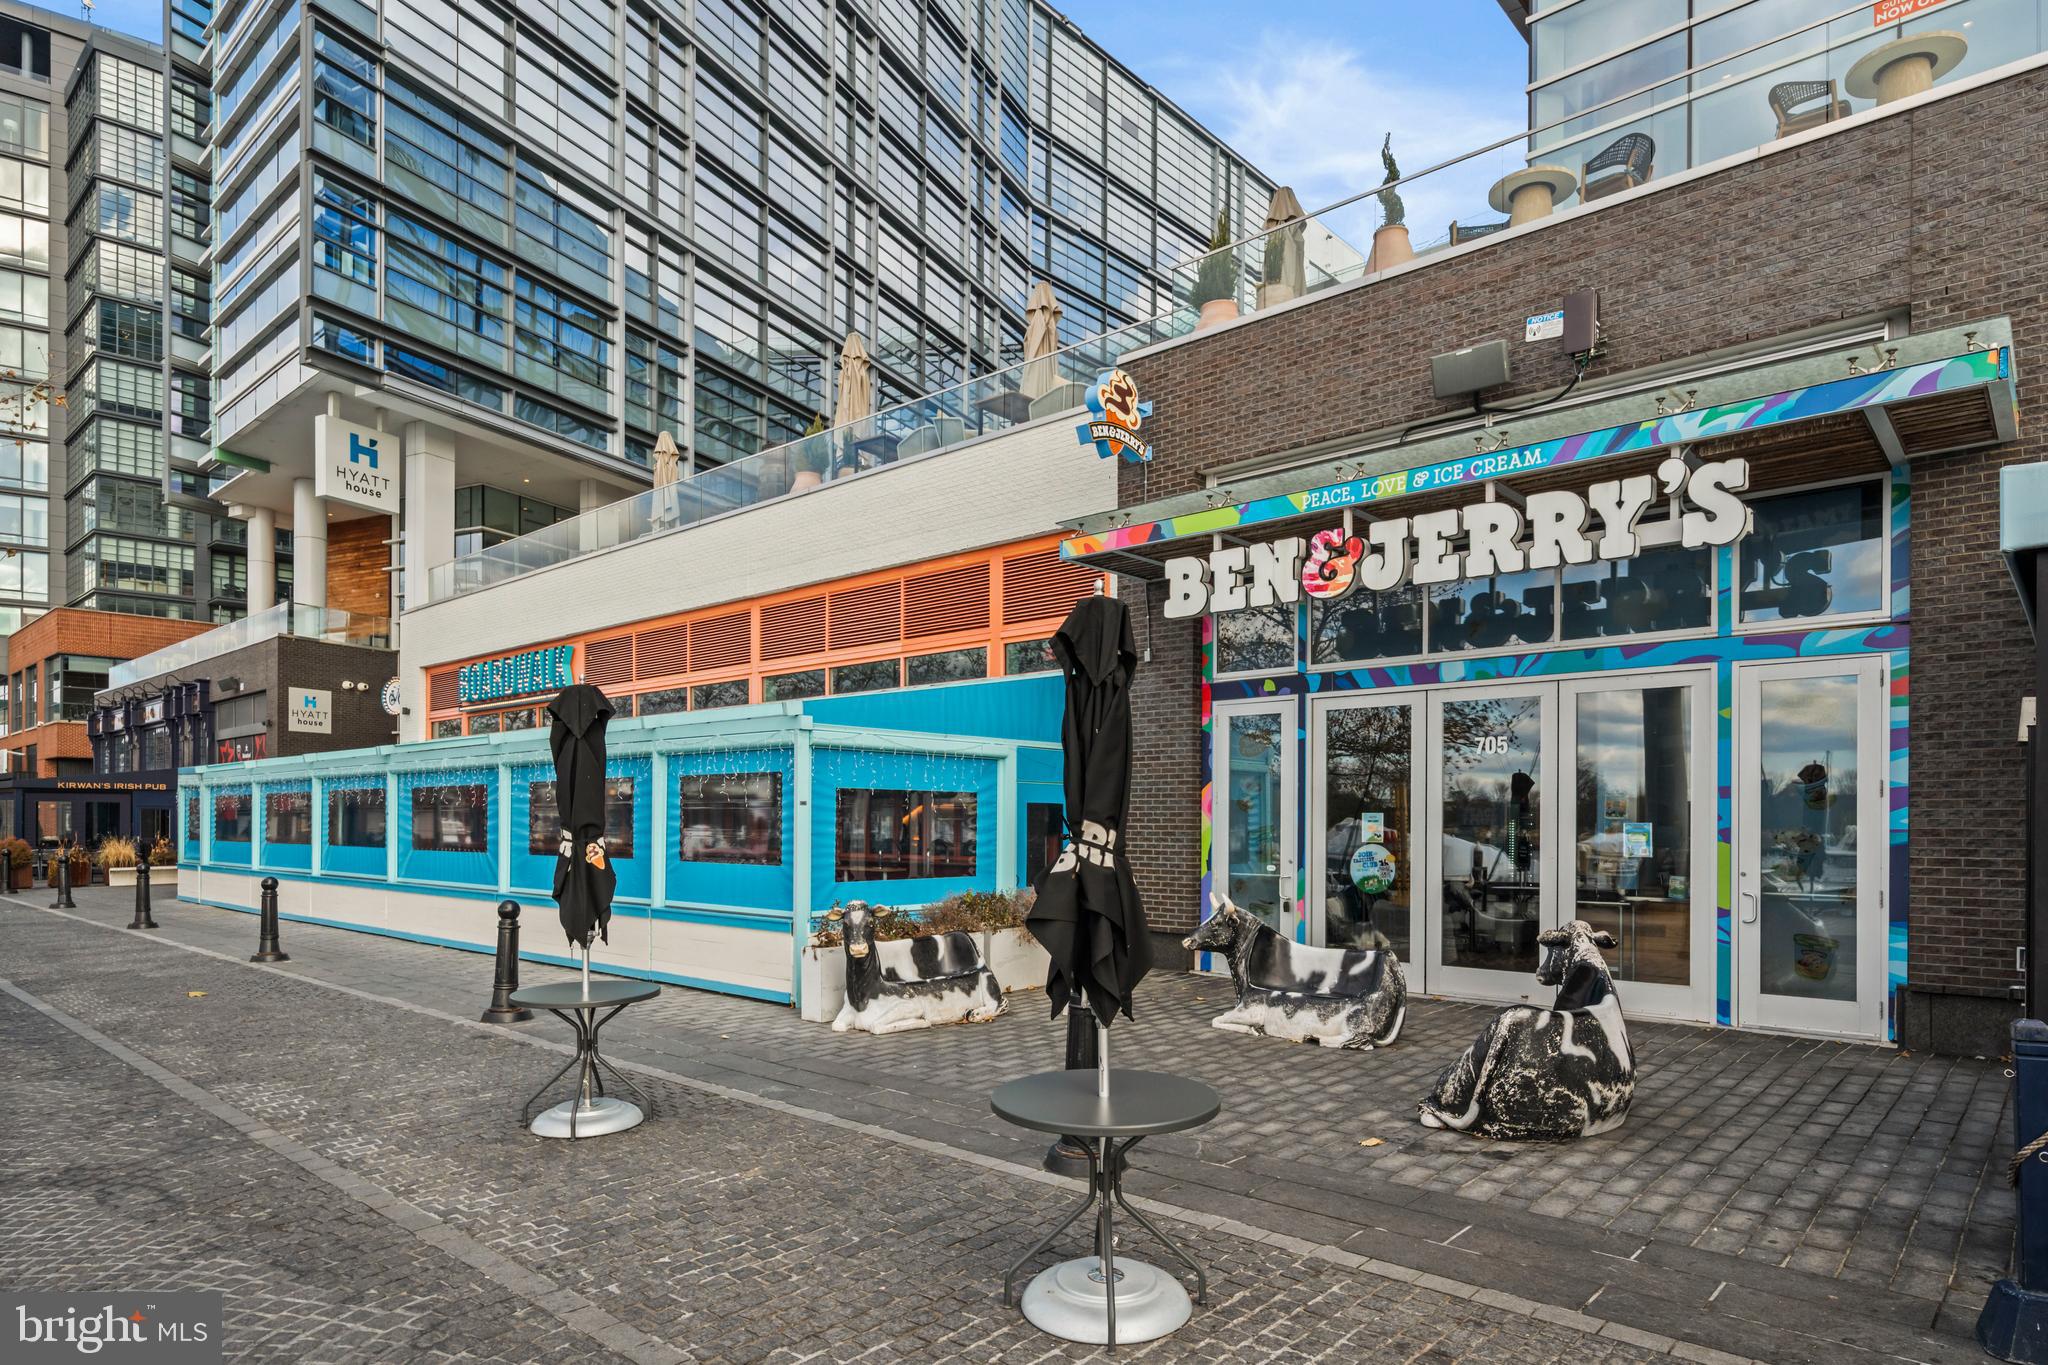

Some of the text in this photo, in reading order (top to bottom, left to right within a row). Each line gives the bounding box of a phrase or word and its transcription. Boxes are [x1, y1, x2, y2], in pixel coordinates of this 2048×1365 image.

[1876, 2, 1914, 23] NOW
[1531, 313, 1560, 324] NOTICE
[336, 465, 390, 490] HYATT
[1302, 486, 1356, 510] PEACE,
[1361, 474, 1407, 499] LOVE
[1412, 470, 1430, 488] &
[1433, 463, 1465, 483] ICE
[345, 480, 382, 498] house
[459, 645, 567, 702] BOARDWALK
[291, 709, 328, 720] HYATT
[297, 718, 323, 727] house
[1474, 735, 1509, 755] 705
[57, 781, 111, 790] KIRWAN'S
[144, 783, 167, 791] PUB
